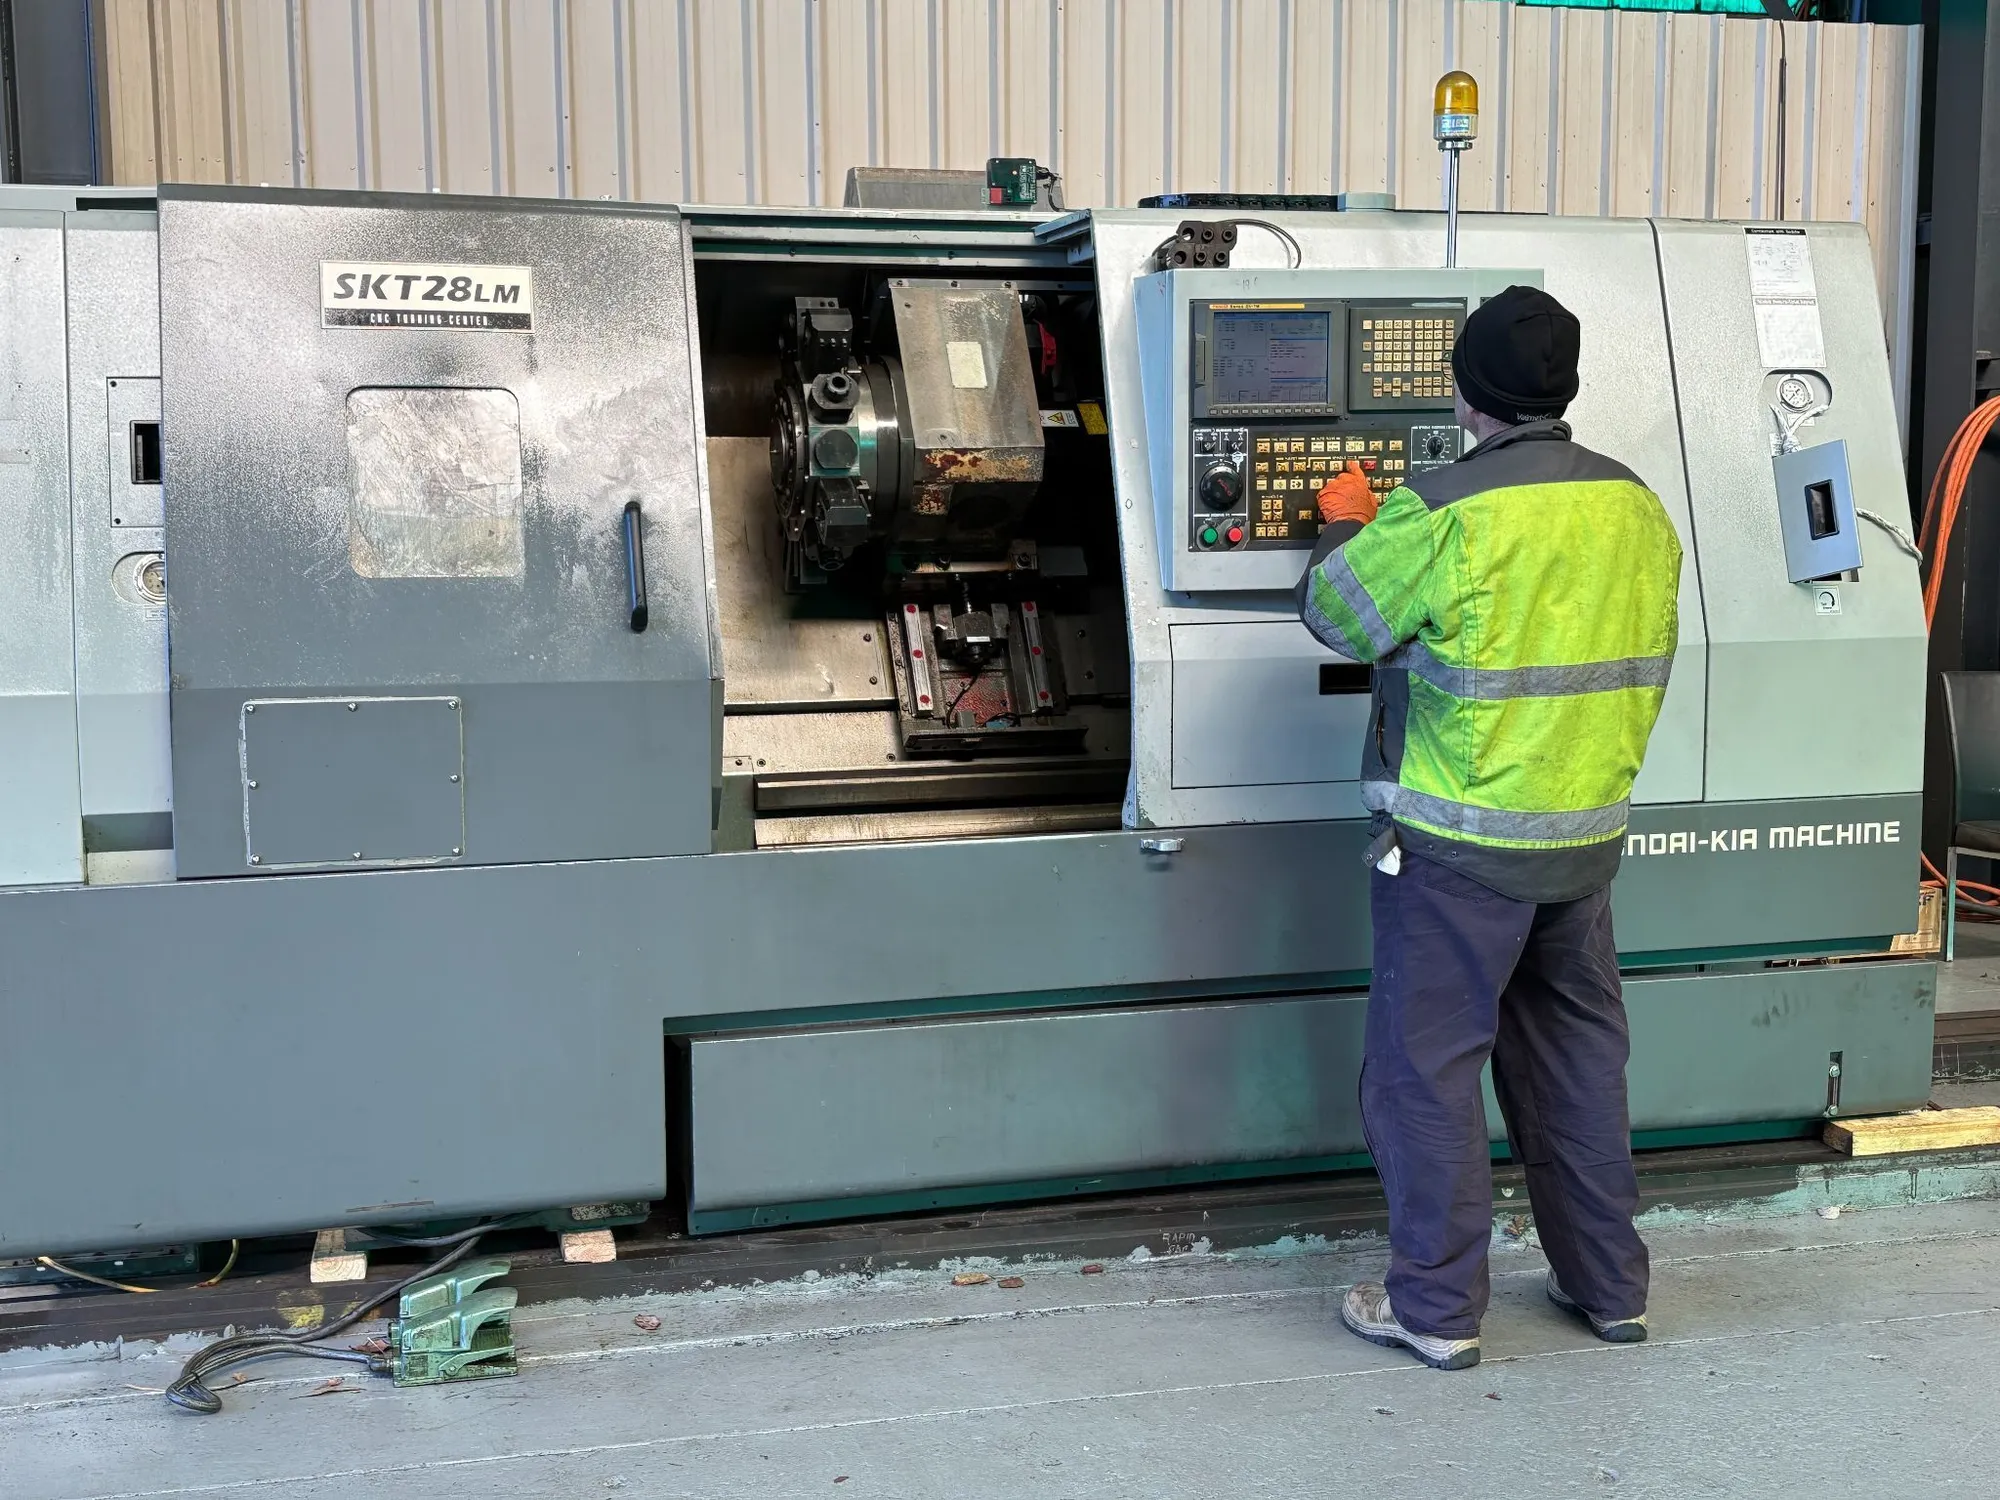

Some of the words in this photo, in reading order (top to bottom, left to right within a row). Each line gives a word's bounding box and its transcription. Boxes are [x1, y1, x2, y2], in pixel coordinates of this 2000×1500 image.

[333, 273, 521, 303] SKT28LM
[1621, 828, 1758, 856] NDAI-KIA
[1769, 821, 1901, 849] MACHINE
